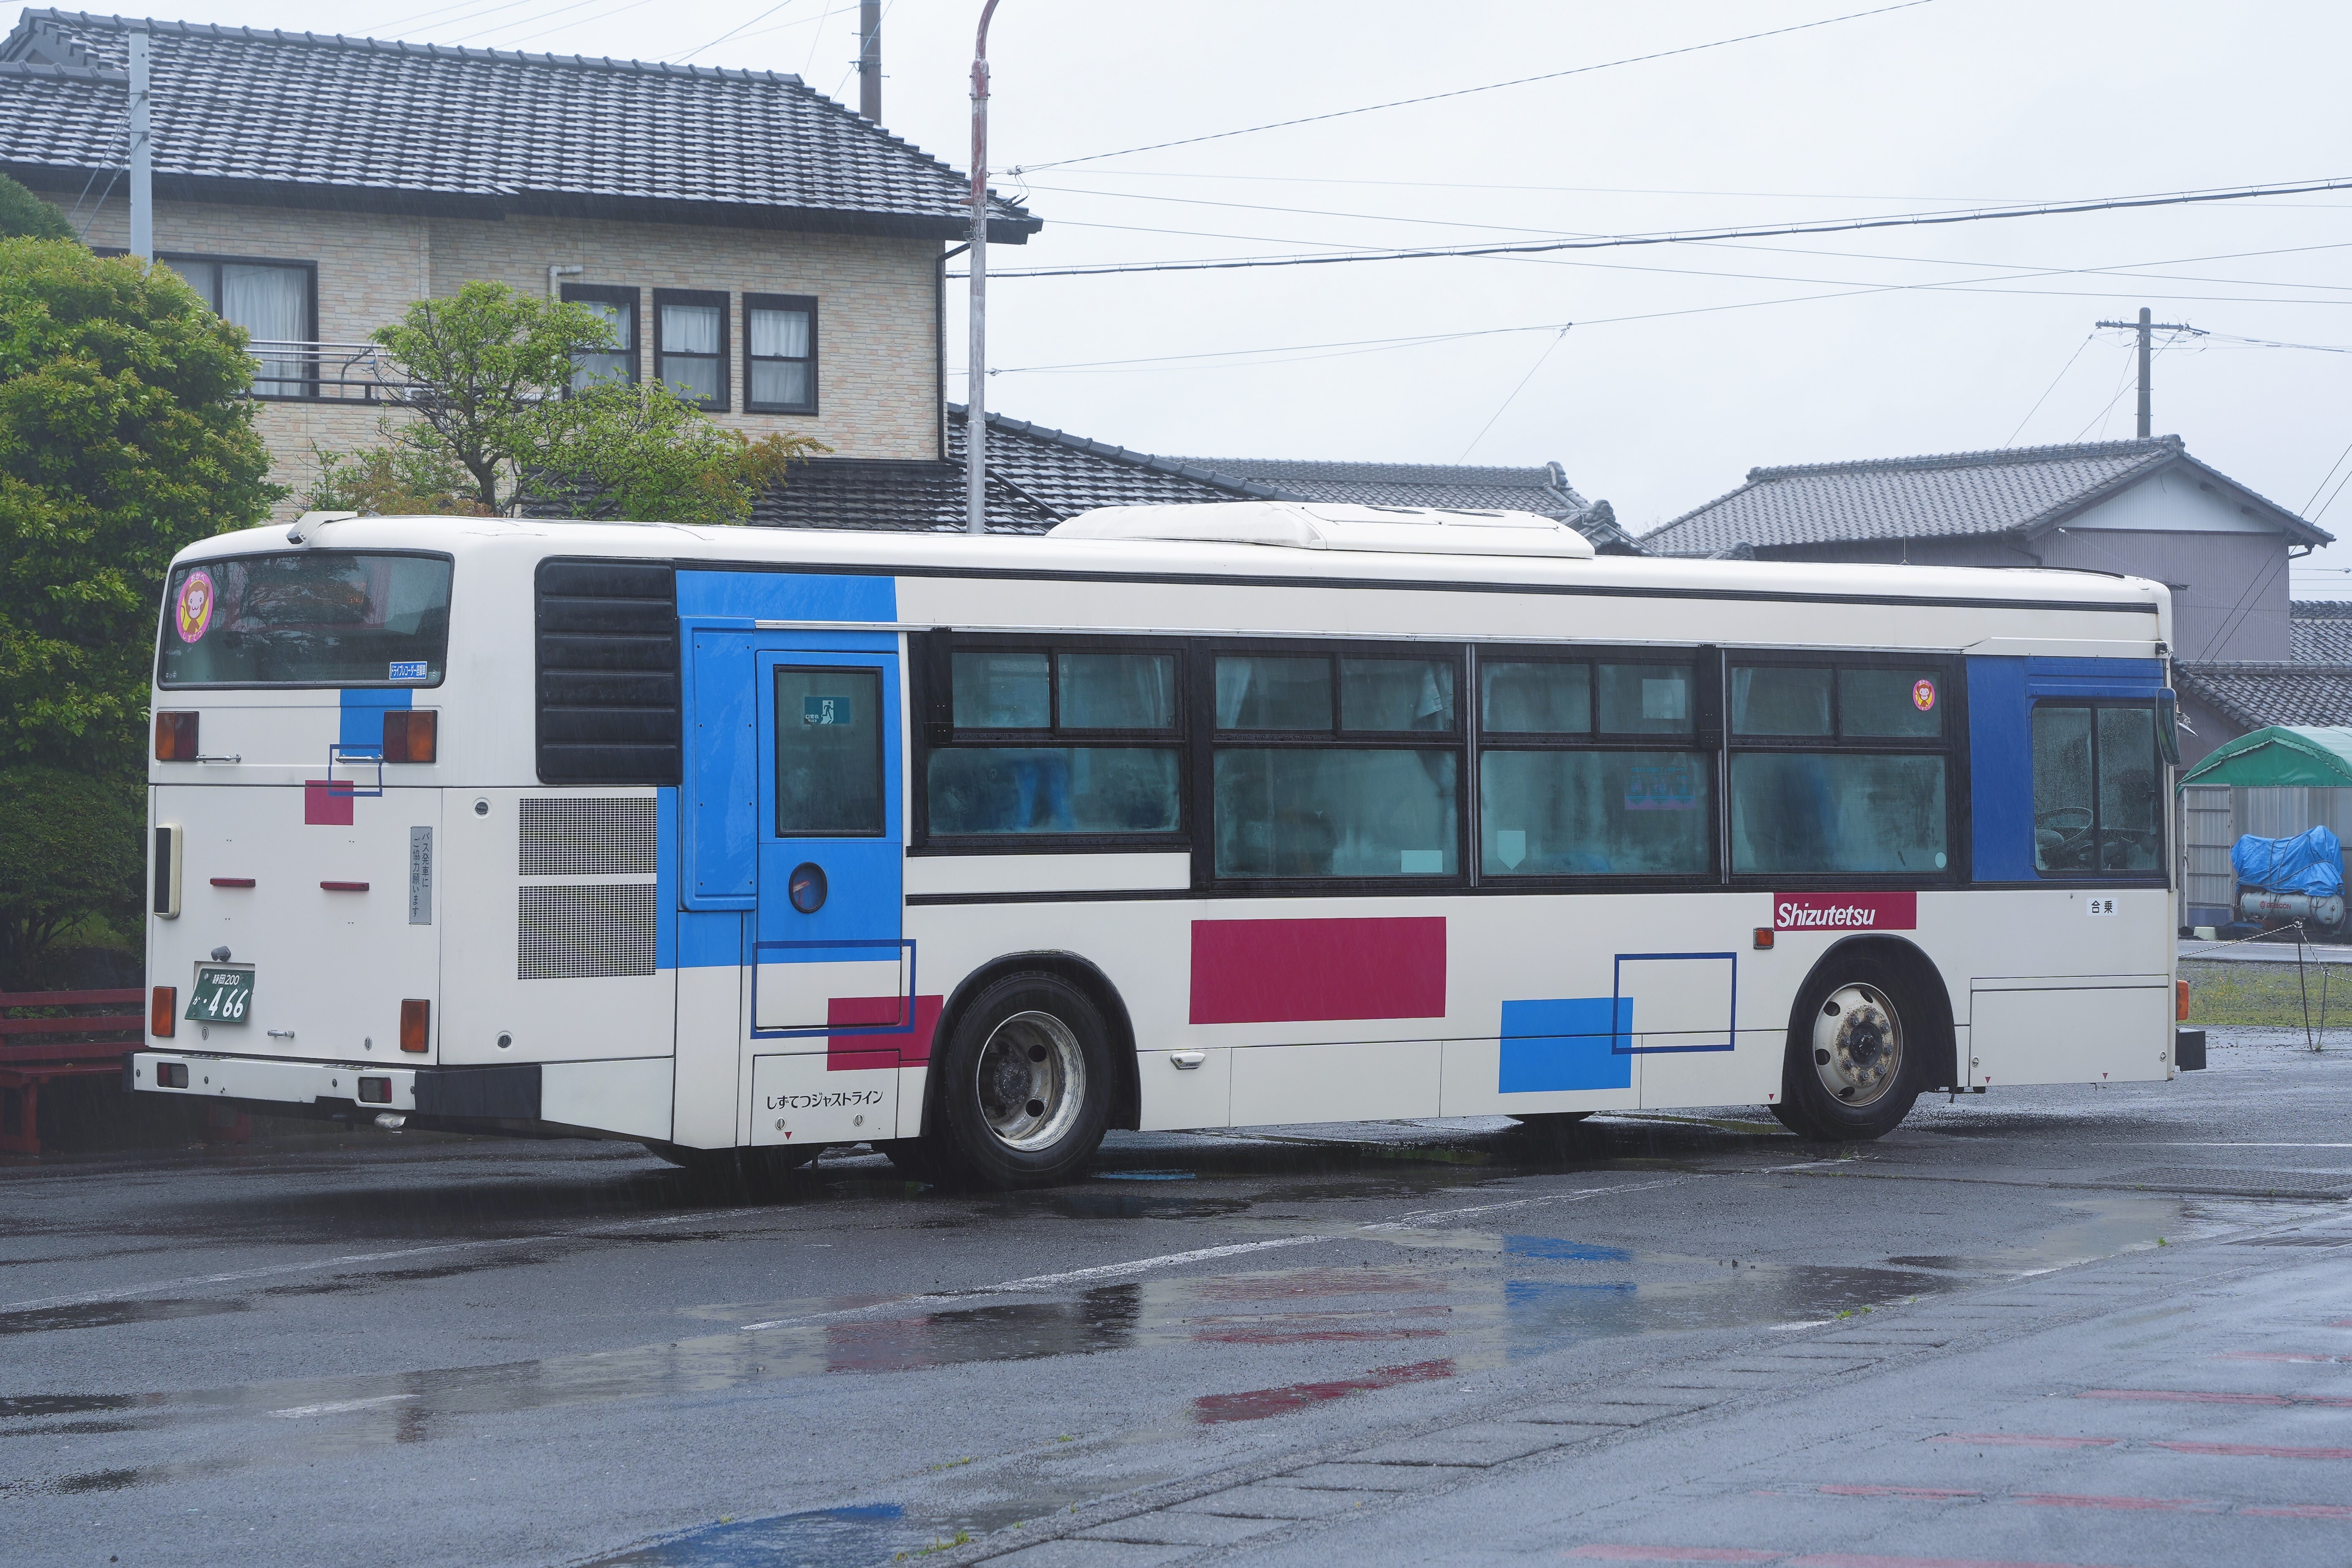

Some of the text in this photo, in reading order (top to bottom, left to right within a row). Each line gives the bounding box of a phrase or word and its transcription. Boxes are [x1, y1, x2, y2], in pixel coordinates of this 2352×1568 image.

[191, 573, 206, 583] おかべ
[182, 630, 202, 642] しずてつ
[412, 837, 420, 917] ご協力願います
[1777, 903, 1876, 927] Shizutetsu
[767, 1091, 883, 1110] しずてつジャストライン
